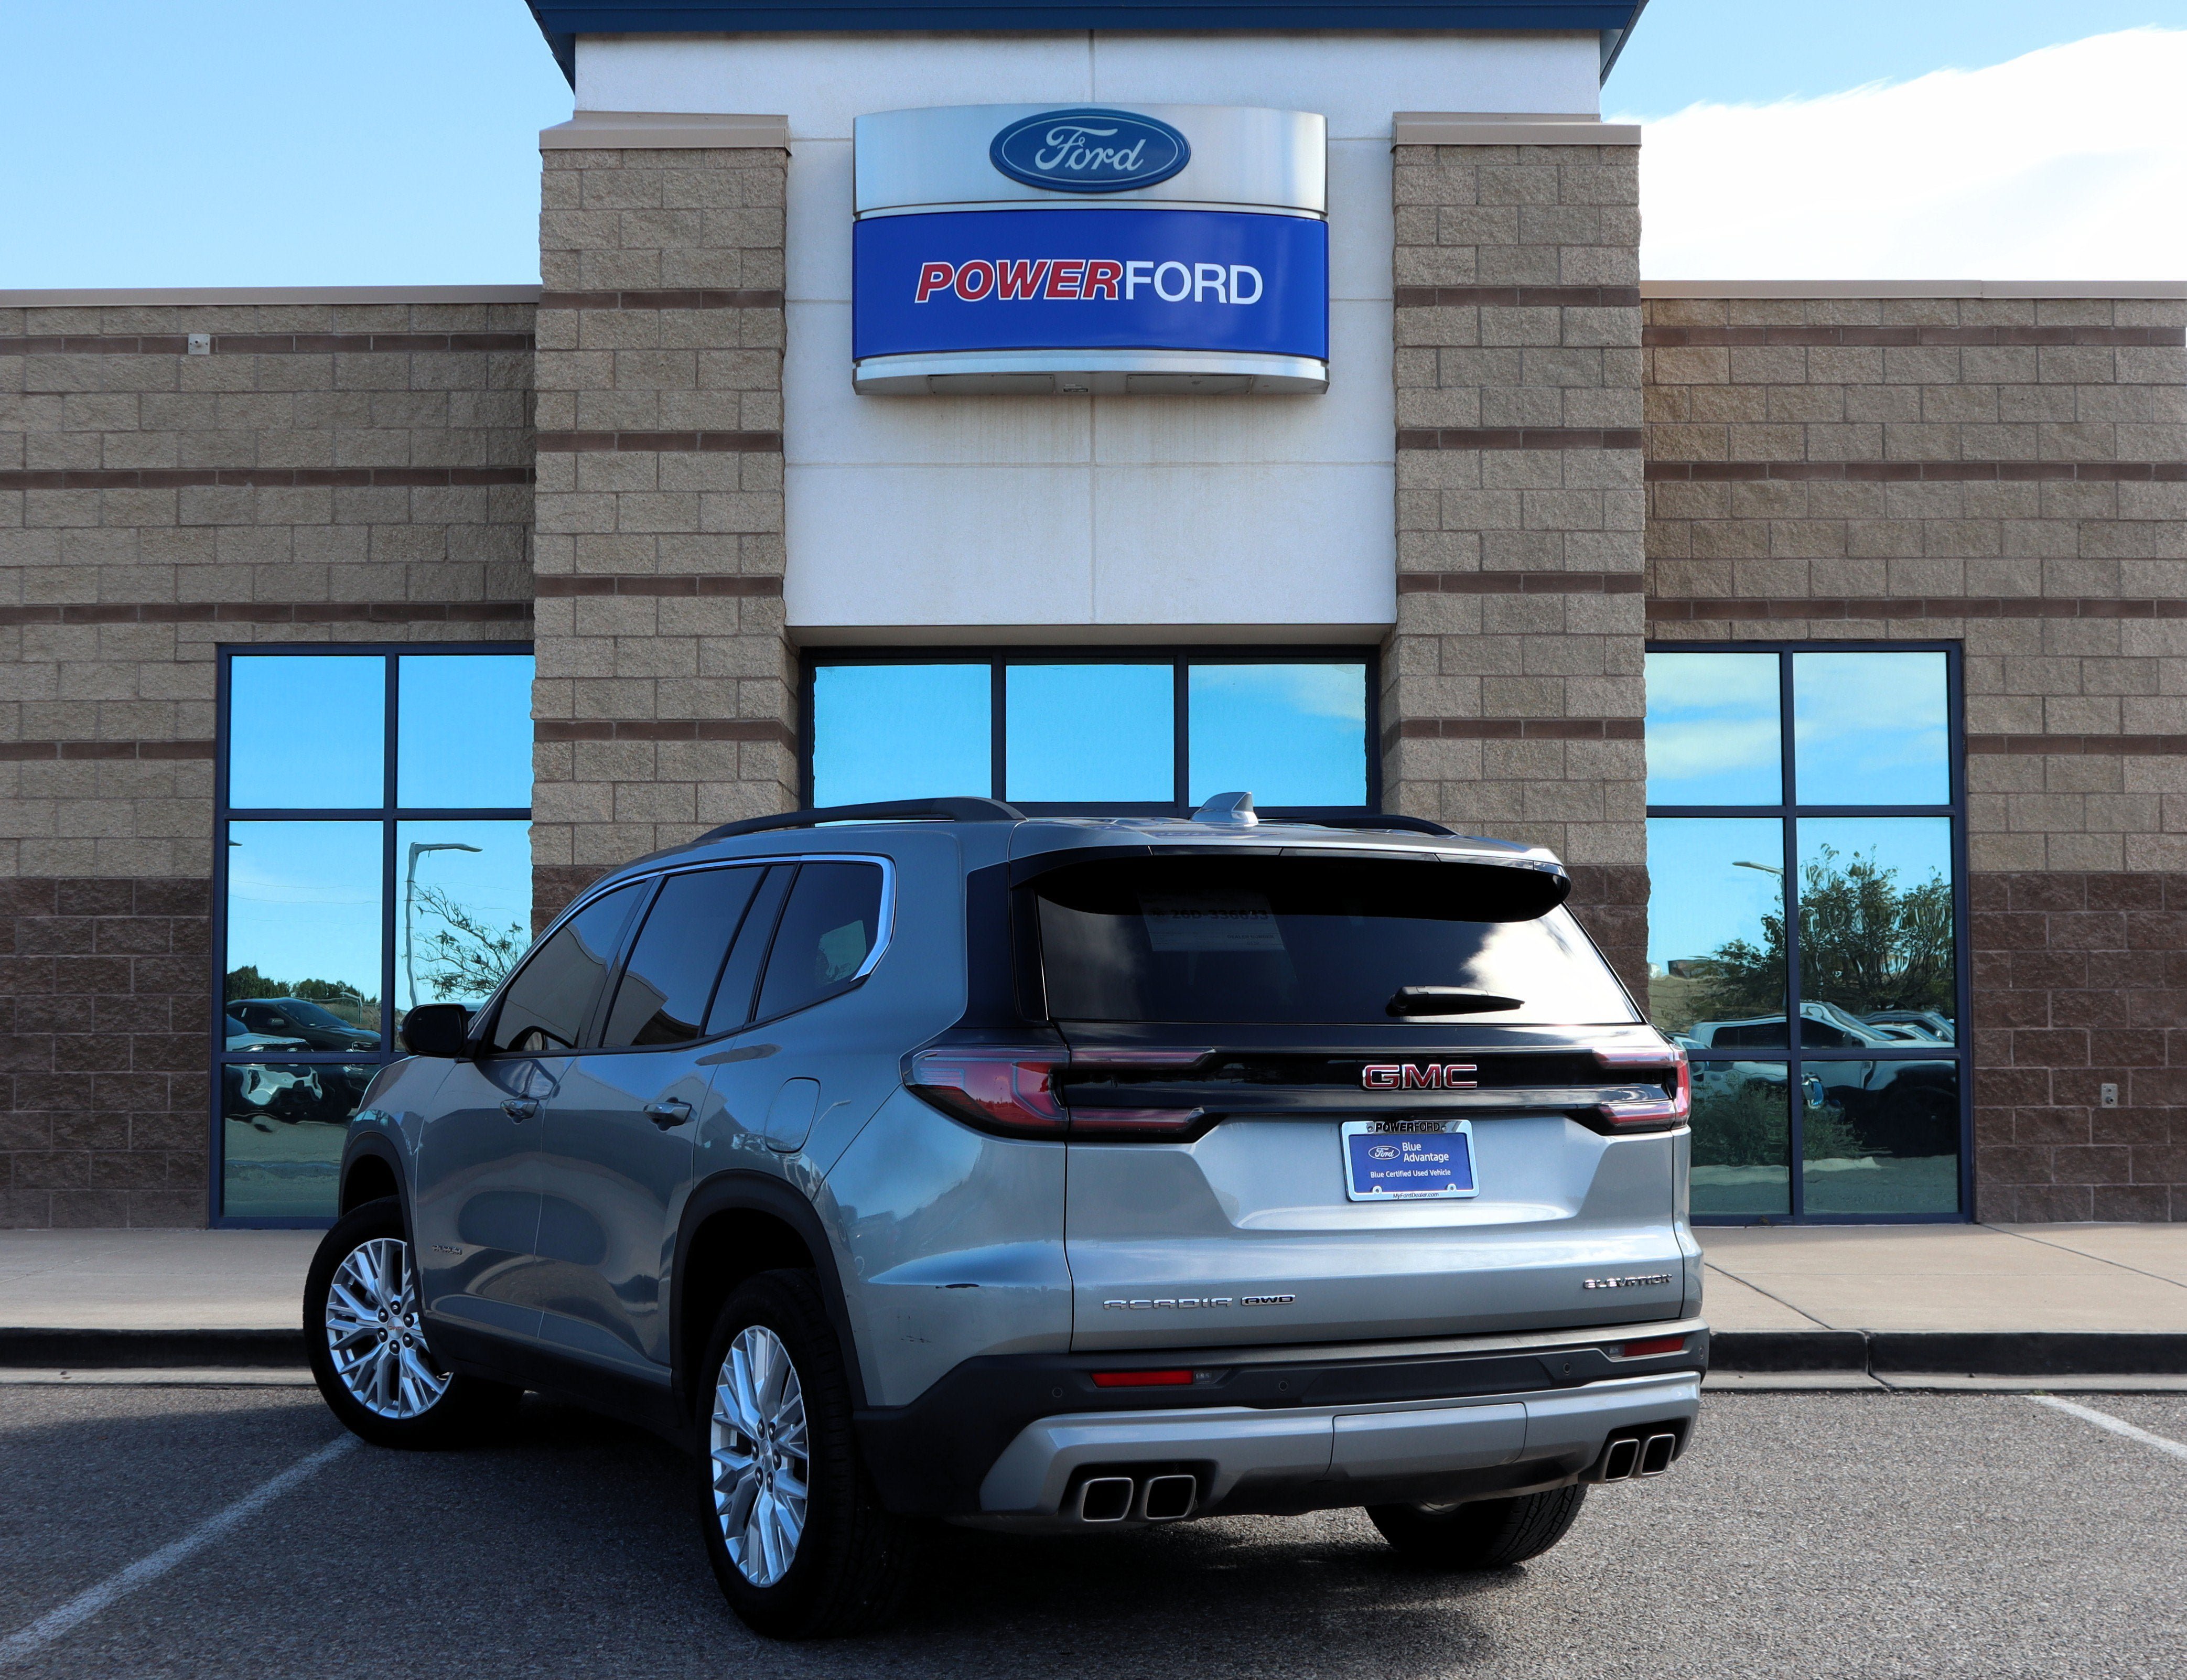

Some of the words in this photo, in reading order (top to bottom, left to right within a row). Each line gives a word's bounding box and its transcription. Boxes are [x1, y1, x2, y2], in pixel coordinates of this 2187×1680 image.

[1035, 125, 1147, 171] Ford
[914, 259, 1264, 305] POWERFORD
[1362, 1064, 1478, 1090] GMC
[1375, 1122, 1441, 1133] POWERFORD
[1374, 1147, 1395, 1158] Ford
[1402, 1141, 1422, 1151] Blue
[1403, 1152, 1449, 1163] Advantage
[1103, 1297, 1233, 1311] ACADIA
[1244, 1295, 1294, 1306] AWD
